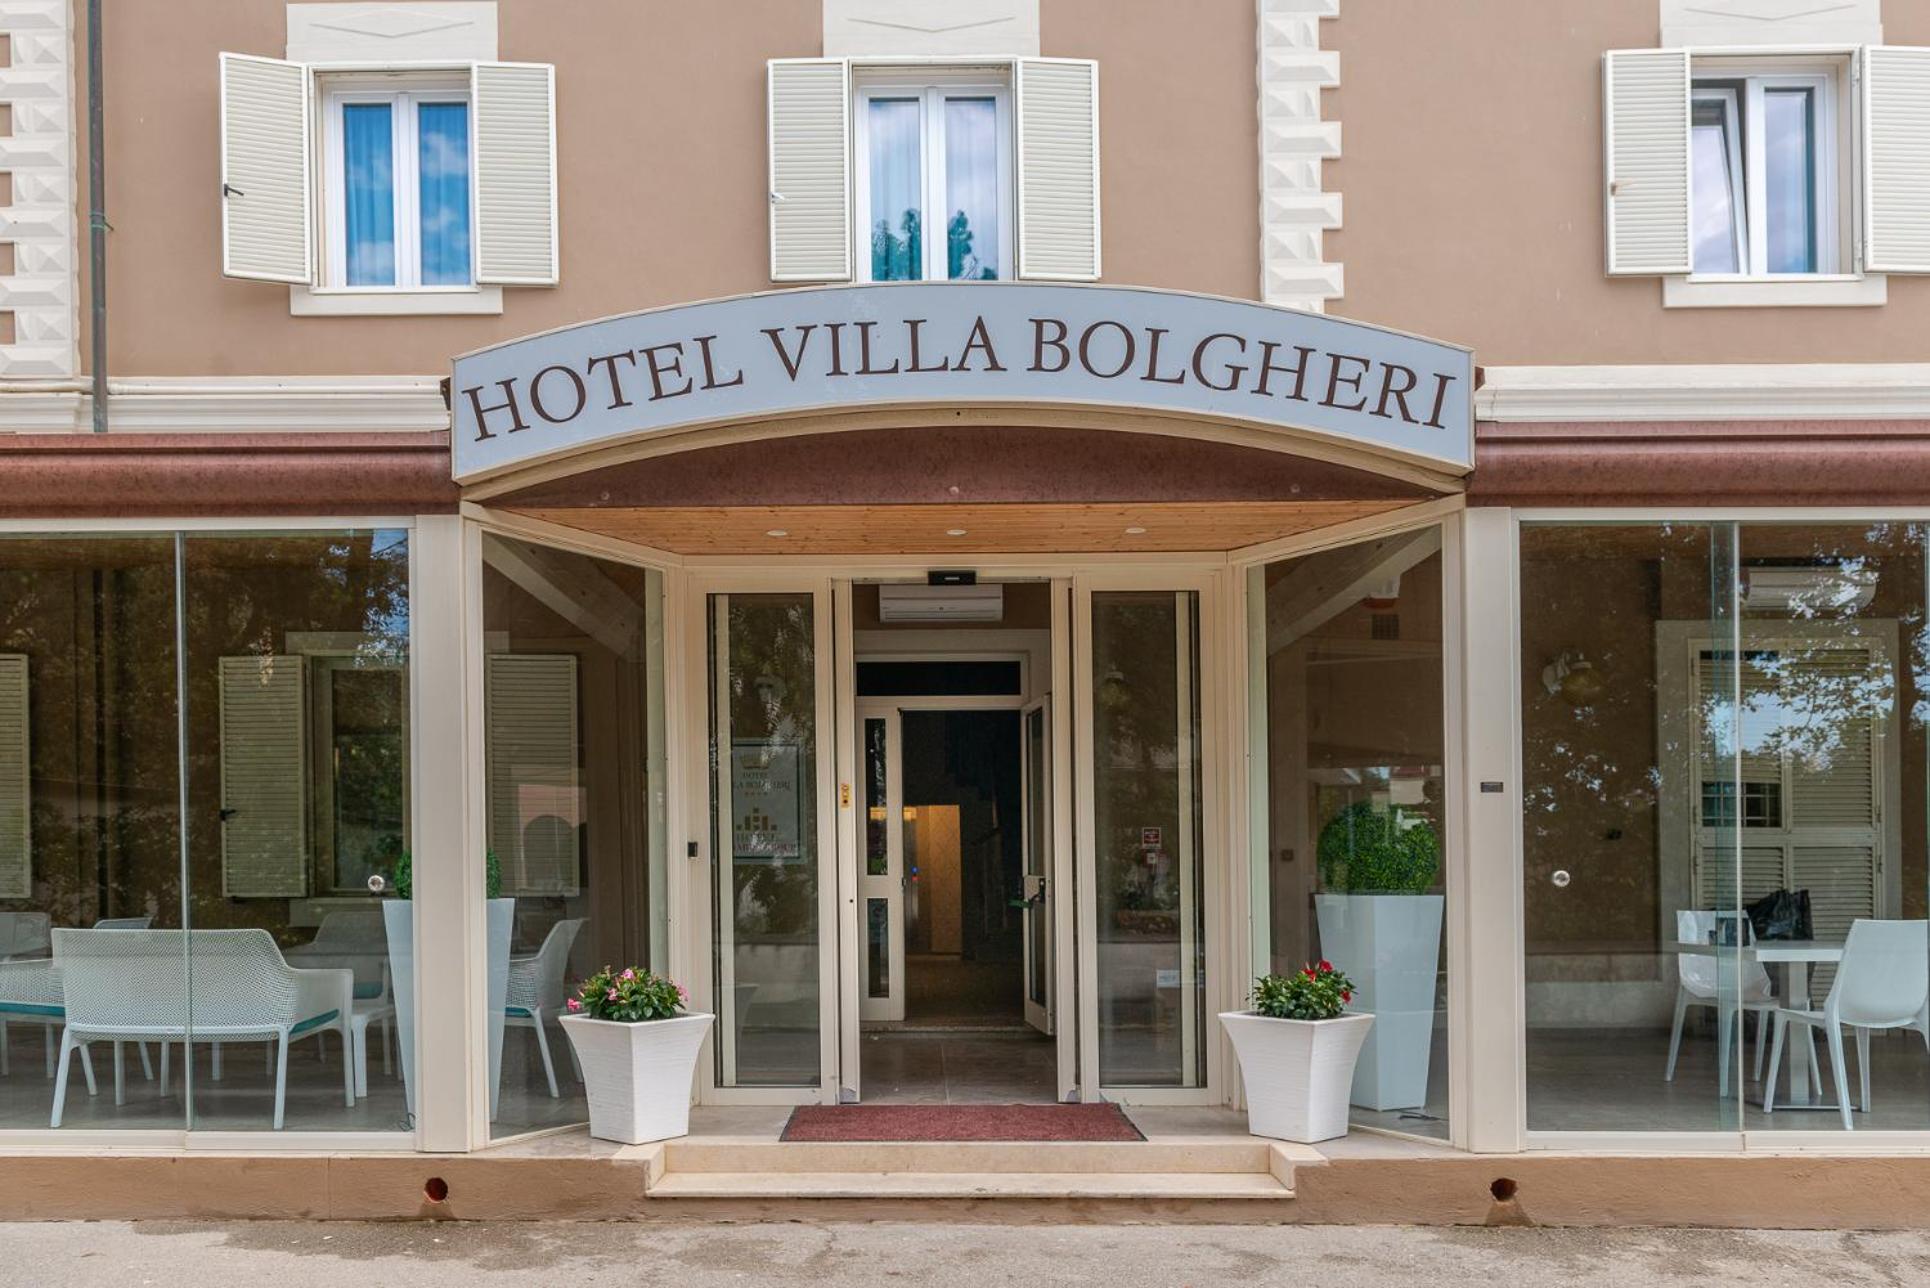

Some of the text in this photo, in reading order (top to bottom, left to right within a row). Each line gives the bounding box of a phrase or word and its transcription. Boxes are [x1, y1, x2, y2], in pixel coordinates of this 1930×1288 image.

[461, 315, 1457, 442] HOTEL VILLA BOLGHERI
